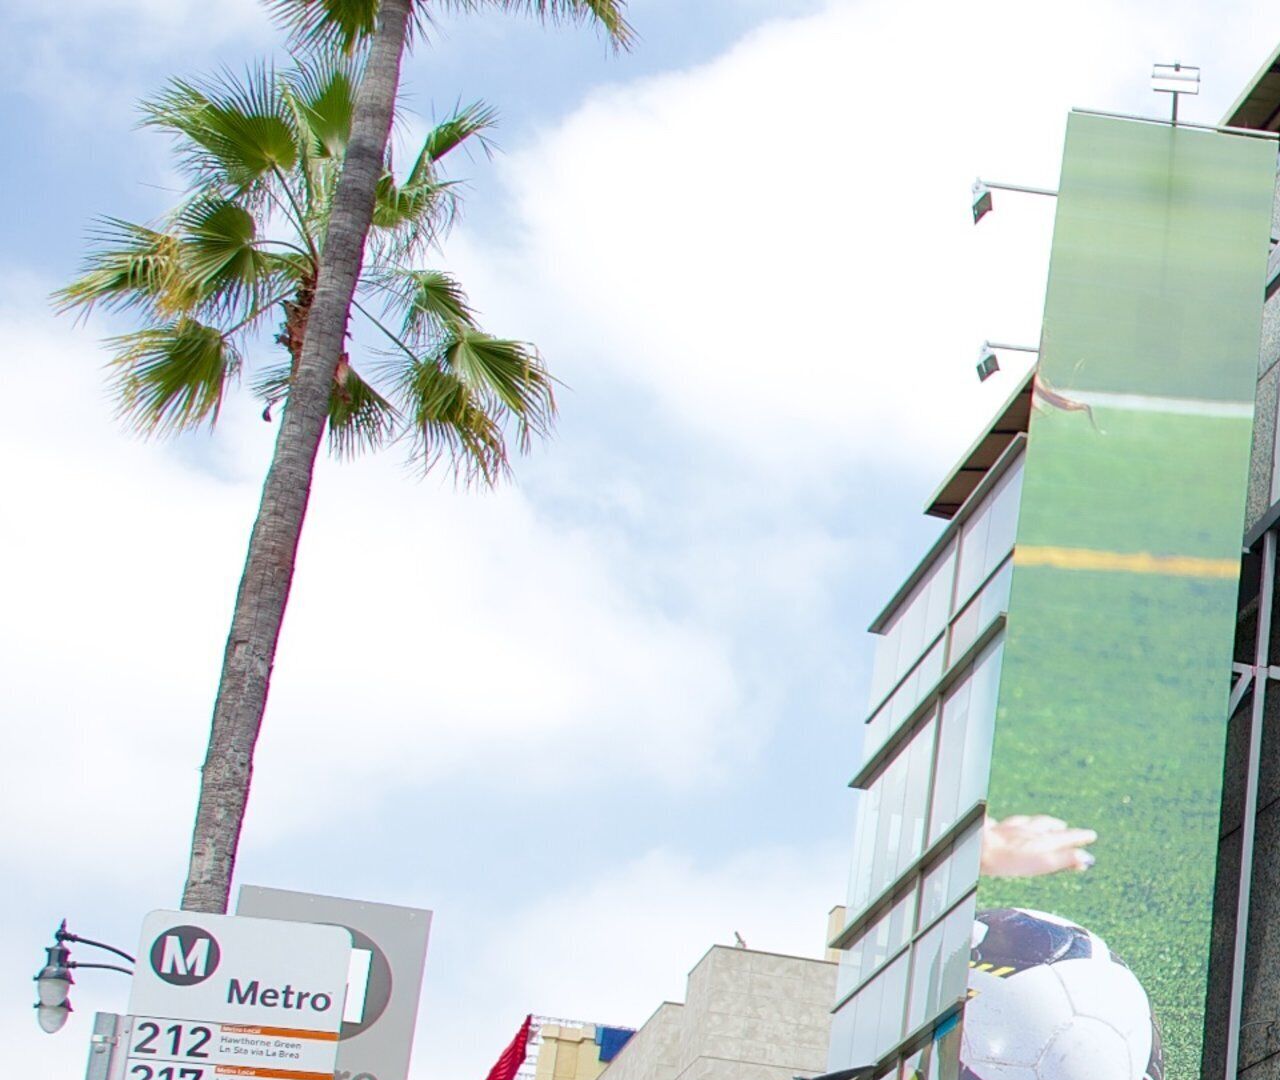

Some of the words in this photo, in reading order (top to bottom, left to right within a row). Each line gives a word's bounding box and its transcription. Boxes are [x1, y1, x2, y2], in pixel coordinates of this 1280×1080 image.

[226, 978, 332, 1012] Metro
[134, 1022, 212, 1058] 212
[219, 1045, 231, 1053] Ln
[233, 1046, 249, 1055] Sta
[251, 1048, 264, 1056] via
[265, 1048, 277, 1057] La
[278, 1050, 300, 1059] Brea
[220, 1036, 271, 1048] Hawthorne
[274, 1040, 302, 1050] Green
